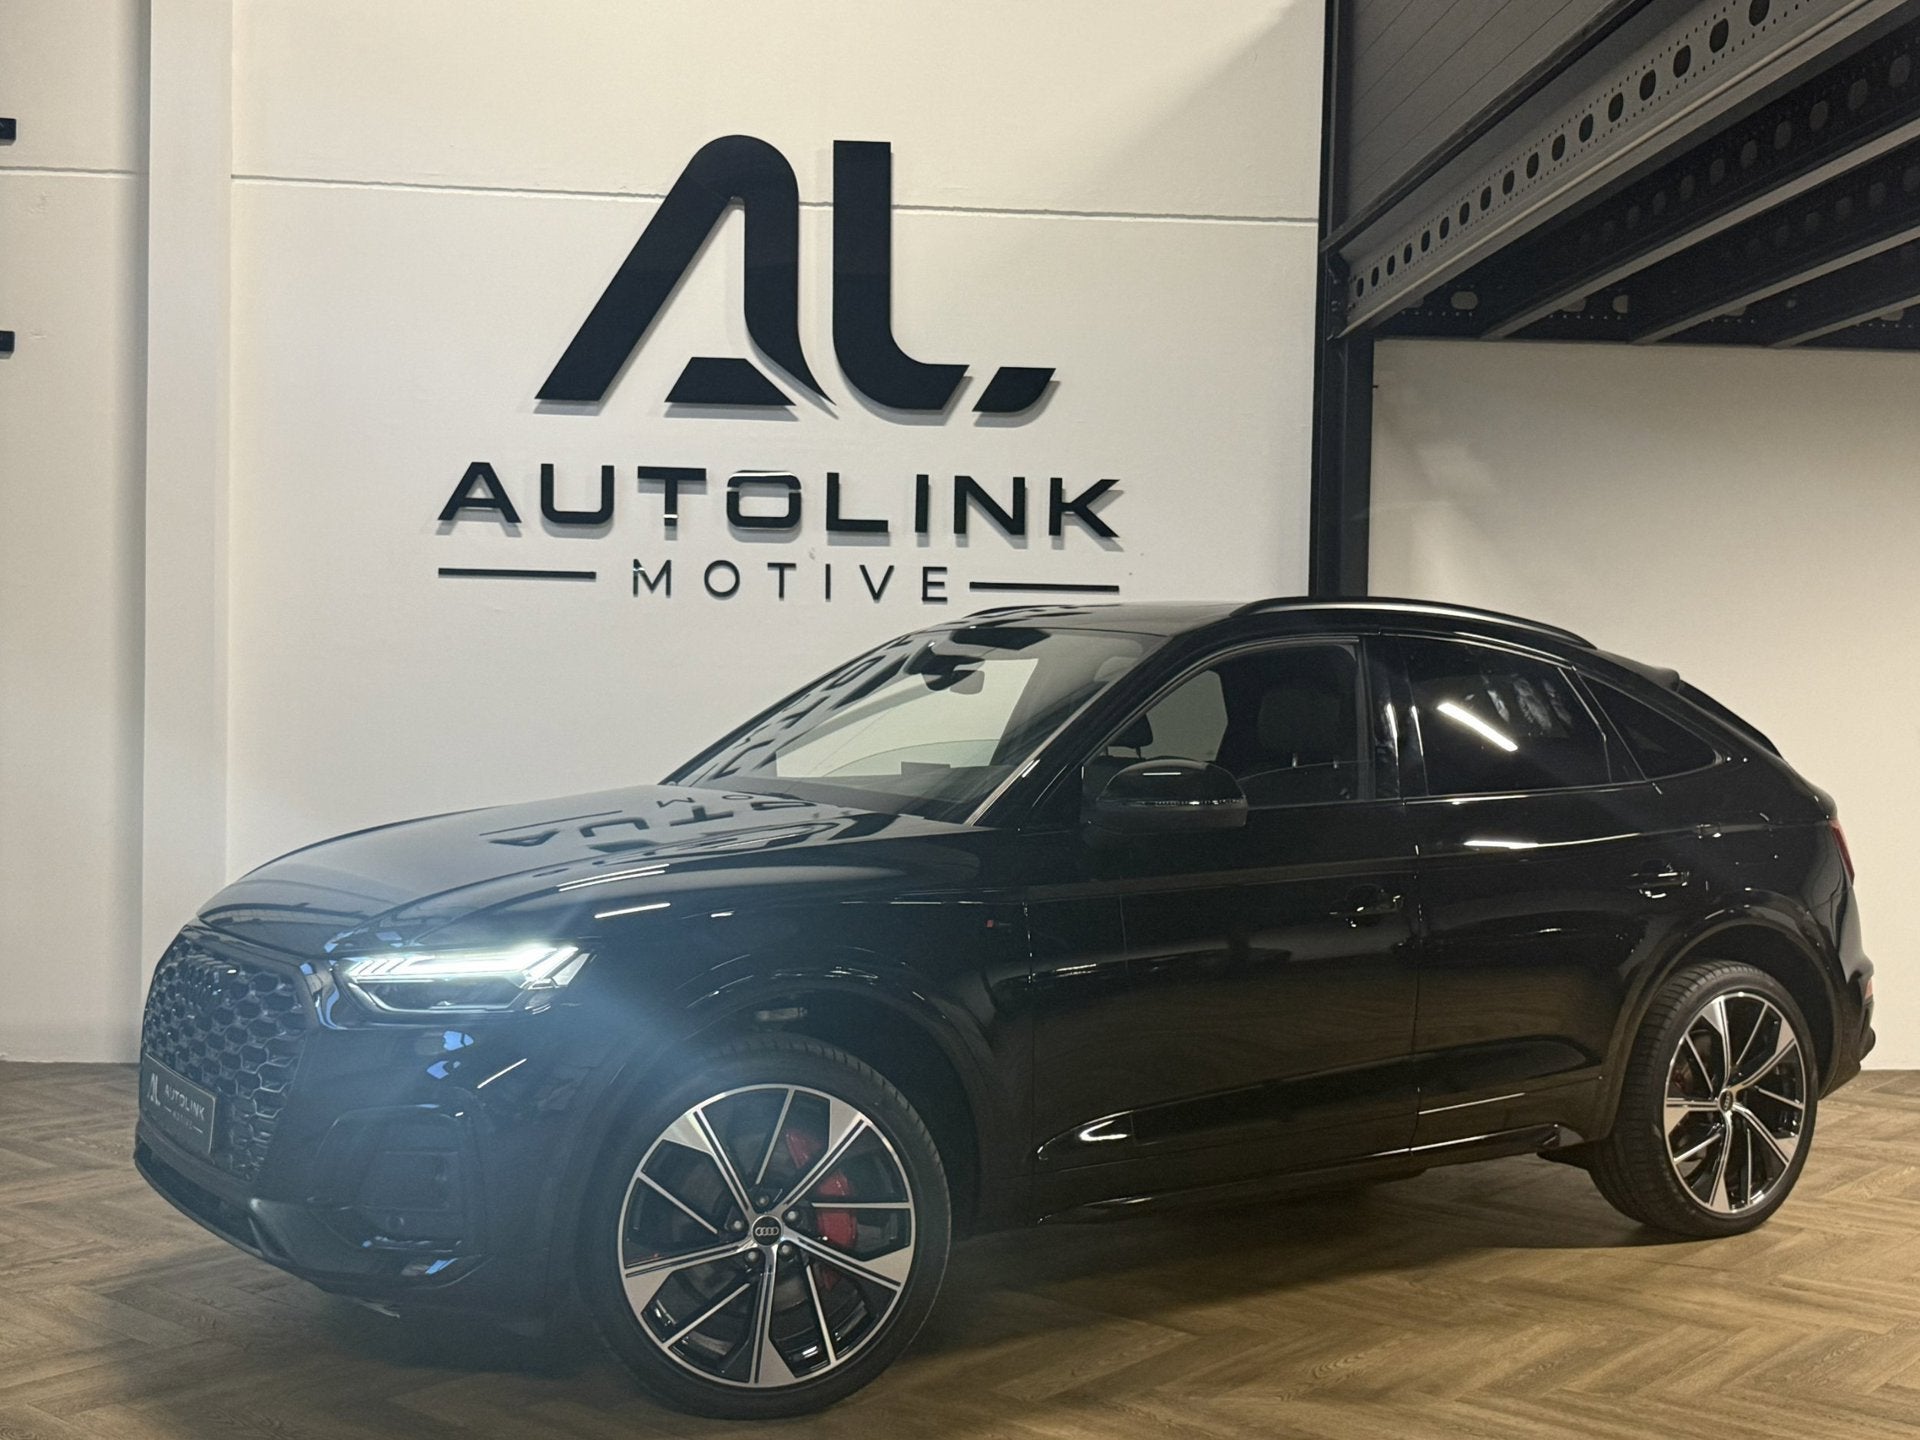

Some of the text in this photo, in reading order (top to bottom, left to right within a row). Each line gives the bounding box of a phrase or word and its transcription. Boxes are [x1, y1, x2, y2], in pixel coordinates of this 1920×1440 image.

[535, 134, 1056, 414] AL
[438, 461, 1120, 539] AUTOLINK
[632, 558, 948, 602] MOTIVE
